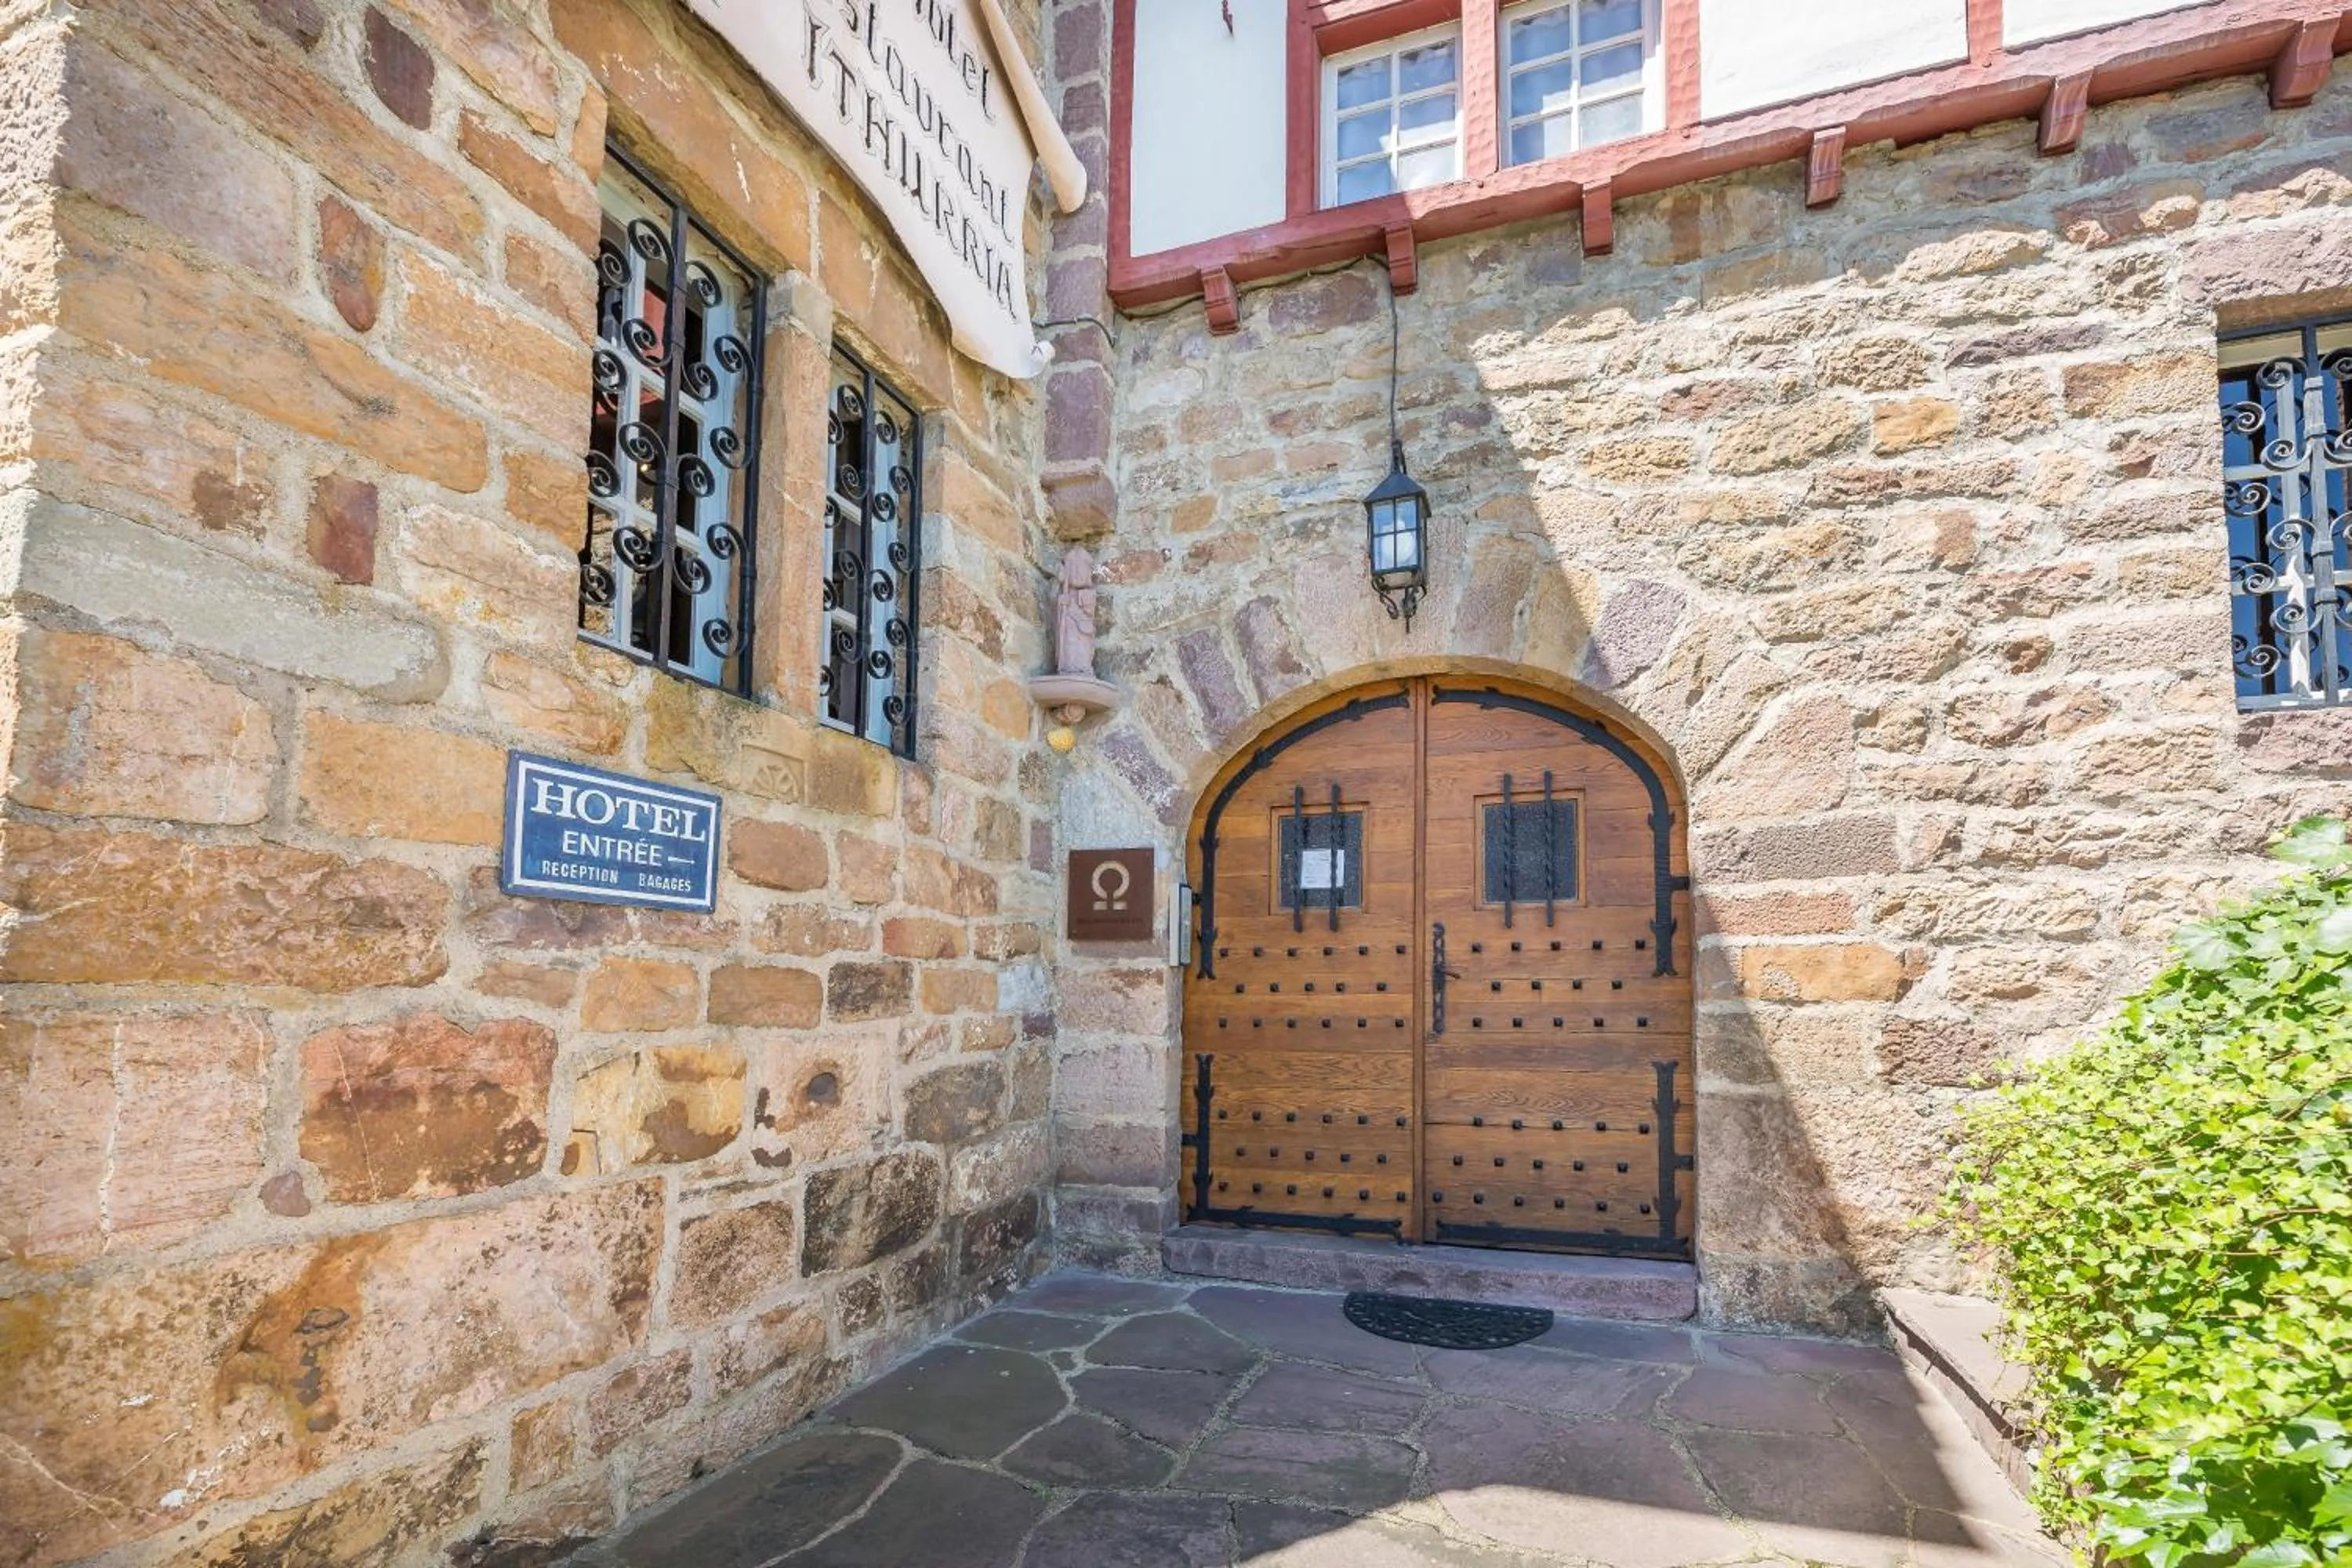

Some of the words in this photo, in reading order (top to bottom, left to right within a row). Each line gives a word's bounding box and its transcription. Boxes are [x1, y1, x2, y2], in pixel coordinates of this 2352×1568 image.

[916, 0, 993, 119] otel
[807, 14, 1018, 321] ITHURRIA
[844, 0, 1013, 244] staurant
[530, 777, 705, 842] HOTEL
[562, 830, 664, 866] ENTRÉE
[542, 860, 619, 884] RECEPTION
[638, 873, 691, 892] BAGAGES
